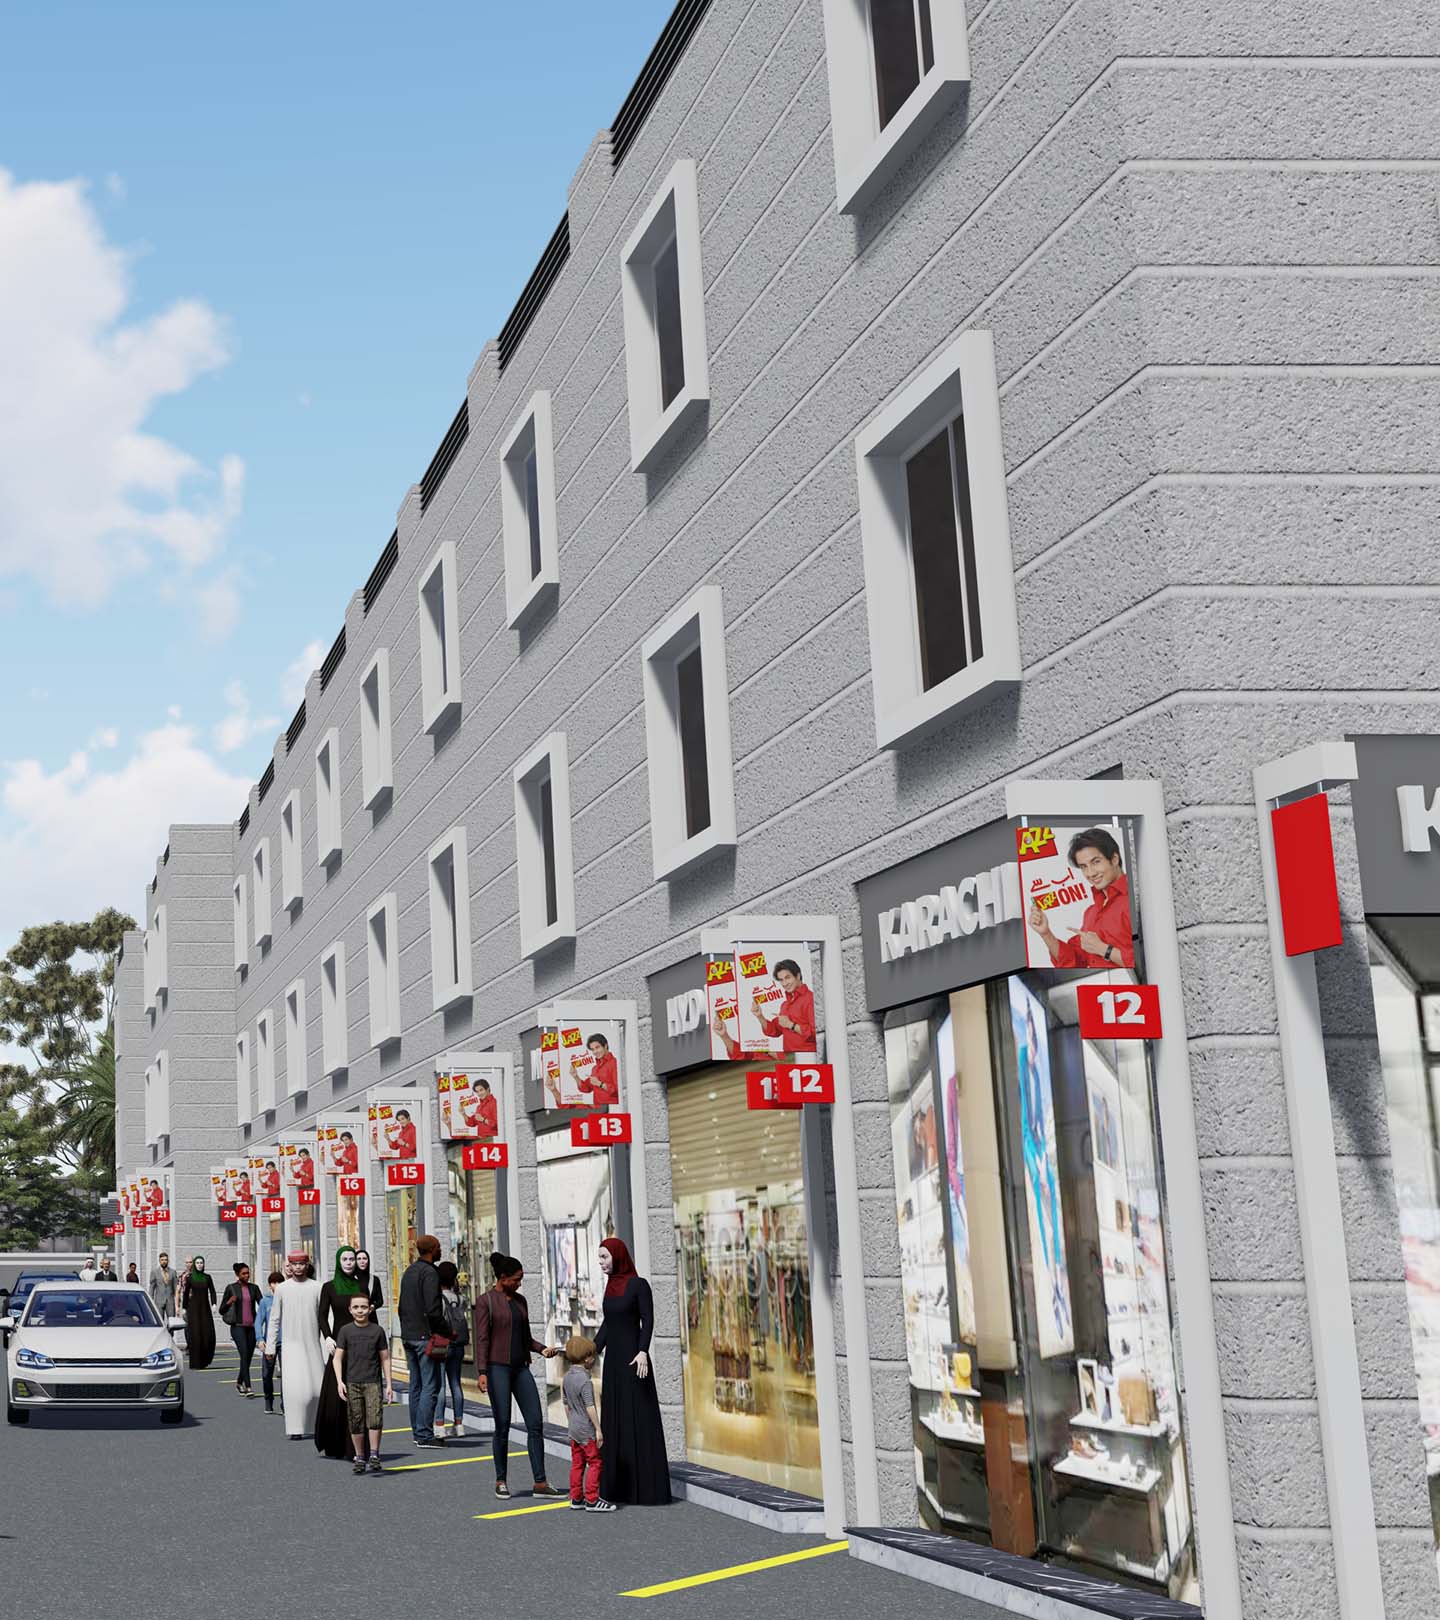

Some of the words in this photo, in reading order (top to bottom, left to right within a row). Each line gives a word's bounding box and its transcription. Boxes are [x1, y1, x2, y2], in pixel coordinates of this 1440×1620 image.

[1058, 882, 1088, 905] ON!
[878, 862, 1022, 963] KARACHI
[768, 989, 783, 1001] ON!
[1097, 990, 1146, 1024] 12
[789, 1068, 823, 1093] 12
[598, 1117, 622, 1136] 13
[480, 1146, 501, 1162] 14
[401, 1166, 418, 1179] 15
[344, 1179, 359, 1190] 16
[303, 1191, 315, 1200] 17
[242, 1206, 253, 1214] 19
[270, 1200, 281, 1209] 18
[224, 1210, 236, 1218] 20
